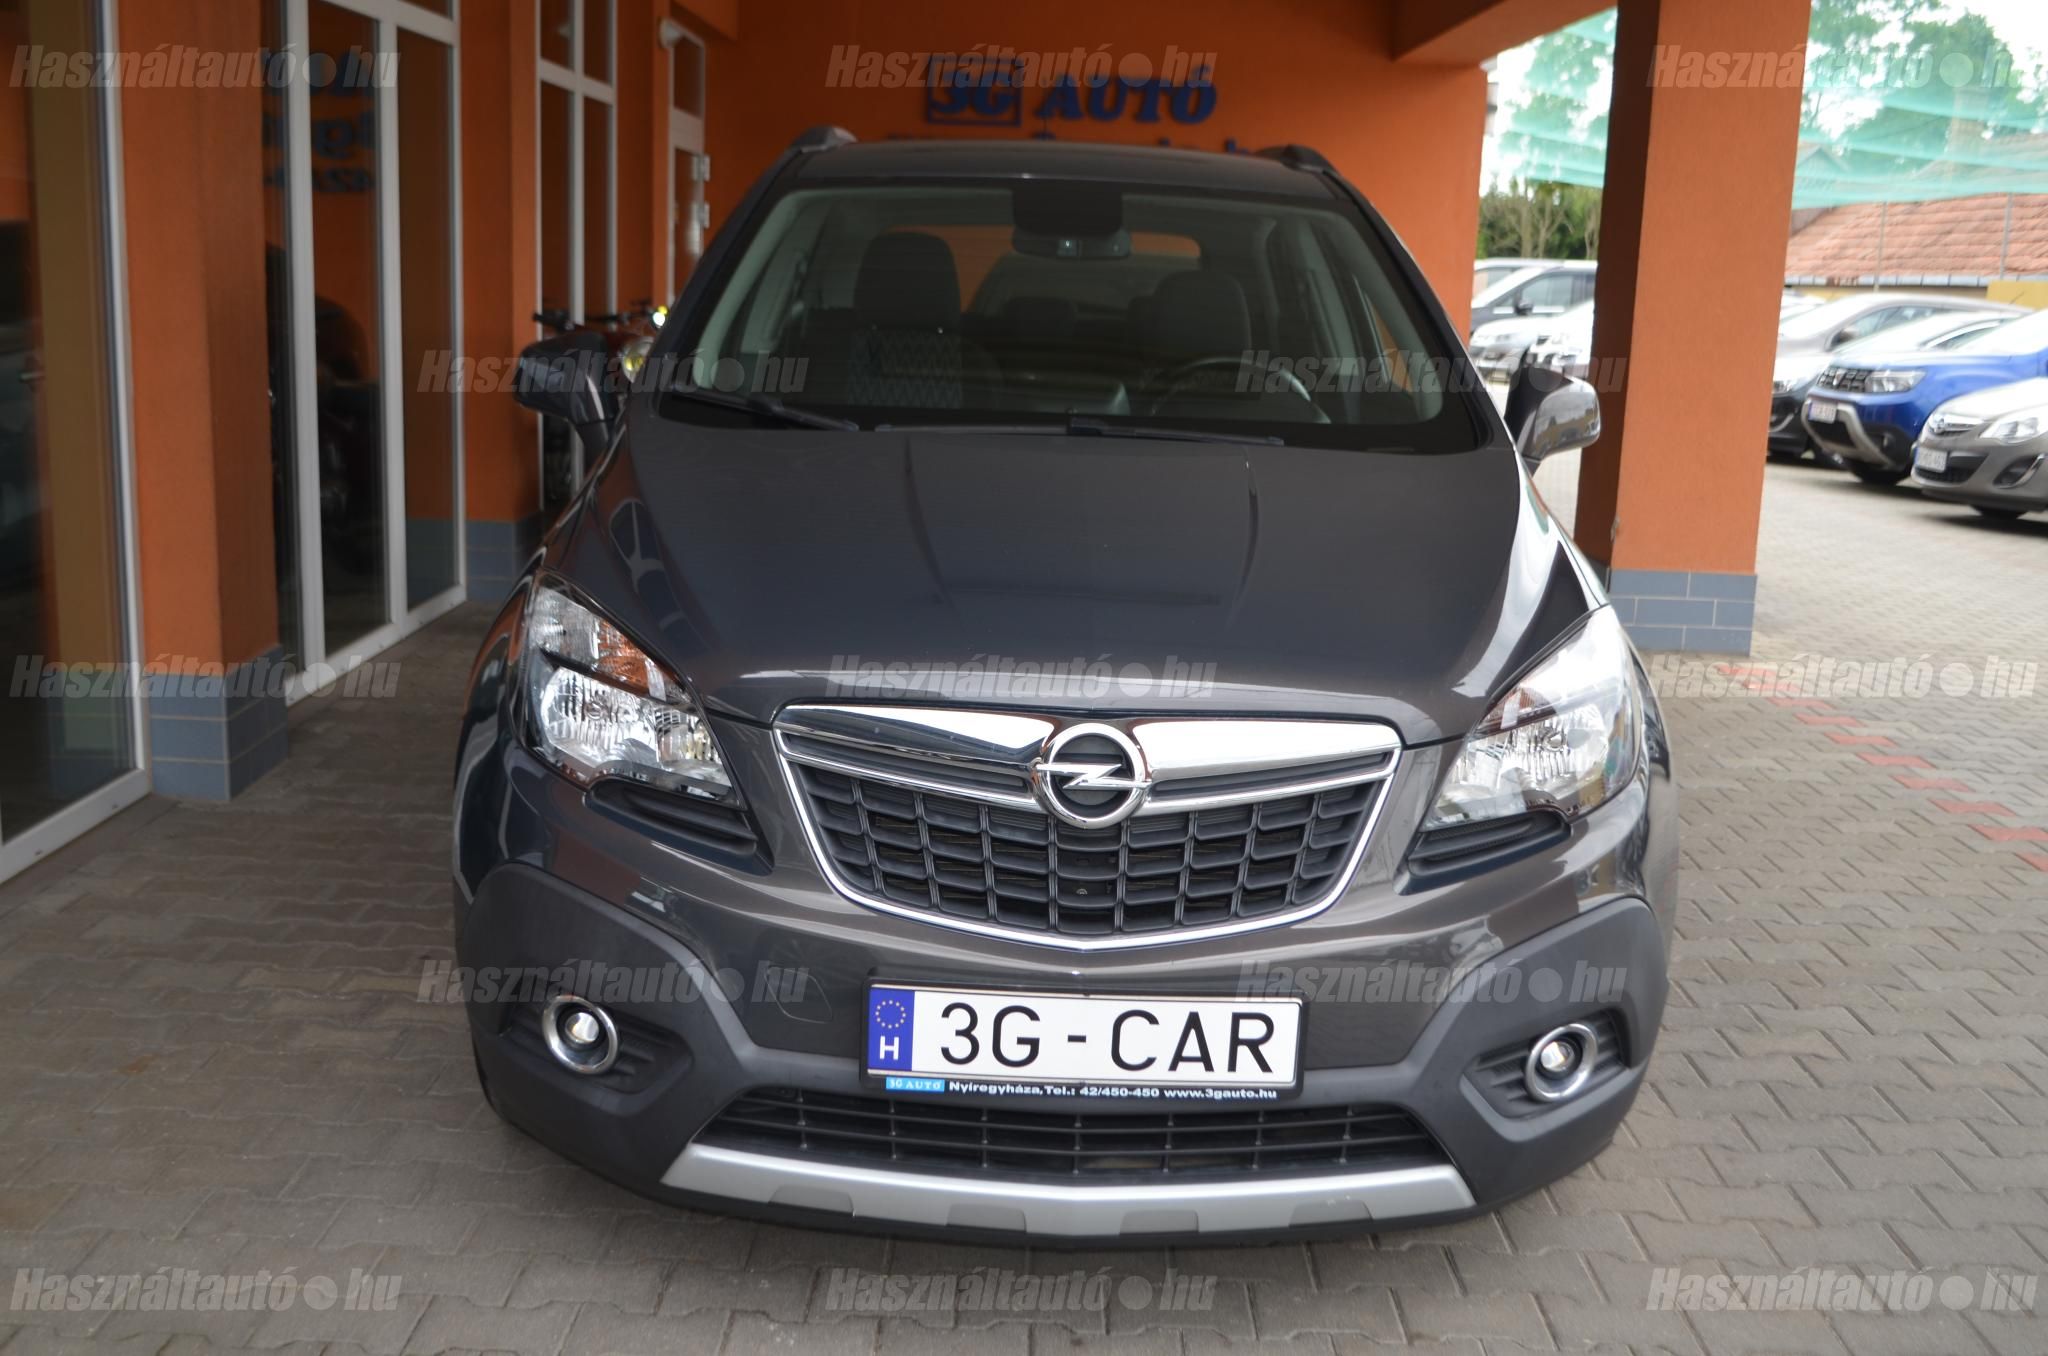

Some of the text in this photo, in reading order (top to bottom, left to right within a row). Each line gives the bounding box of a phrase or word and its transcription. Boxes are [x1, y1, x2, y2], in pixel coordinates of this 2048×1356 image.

[879, 1035, 899, 1060] H
[940, 1002, 1041, 1068] 3G
[1110, 1009, 1275, 1073] CAR
[1079, 1086, 1160, 1098] 42/450-450
[1163, 1087, 1277, 1100] www.3gauto.hu
